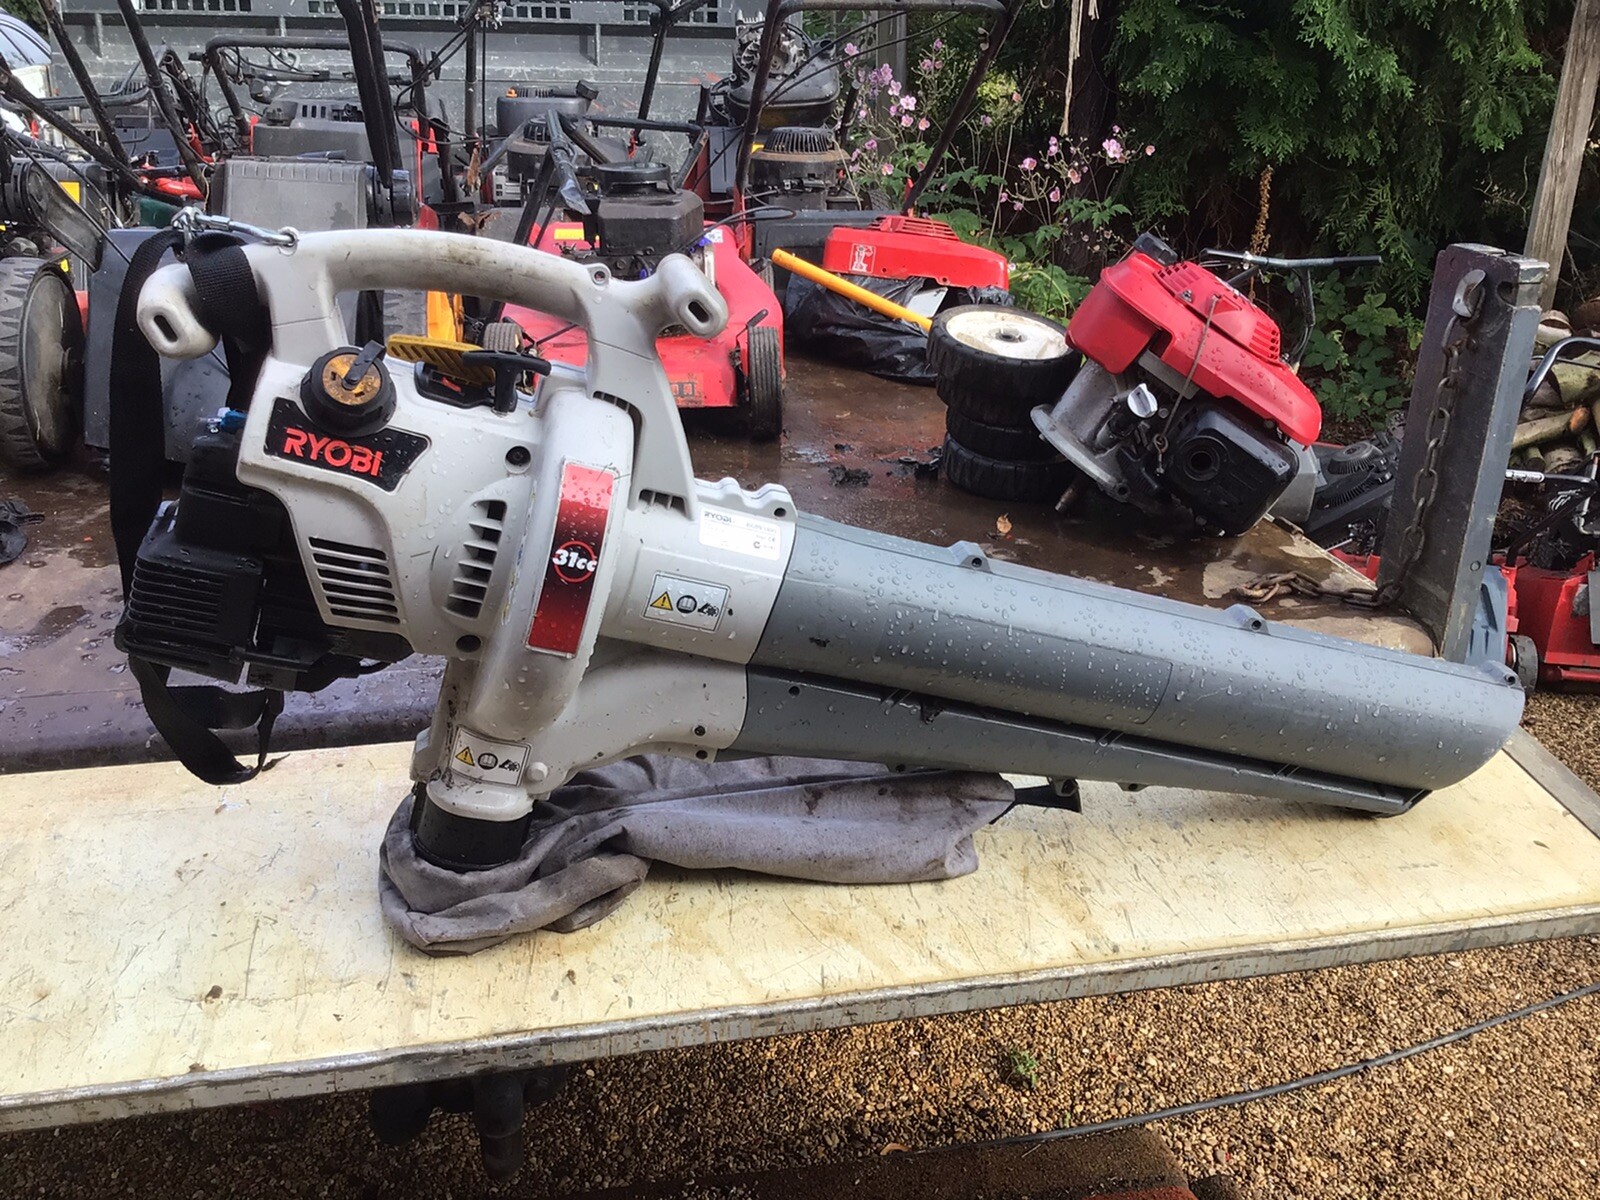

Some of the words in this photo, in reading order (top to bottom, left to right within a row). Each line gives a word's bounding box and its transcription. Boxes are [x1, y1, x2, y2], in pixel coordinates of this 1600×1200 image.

[284, 427, 382, 476] RYOBI
[704, 511, 732, 524] RYOBI
[552, 548, 598, 572] 31cc
